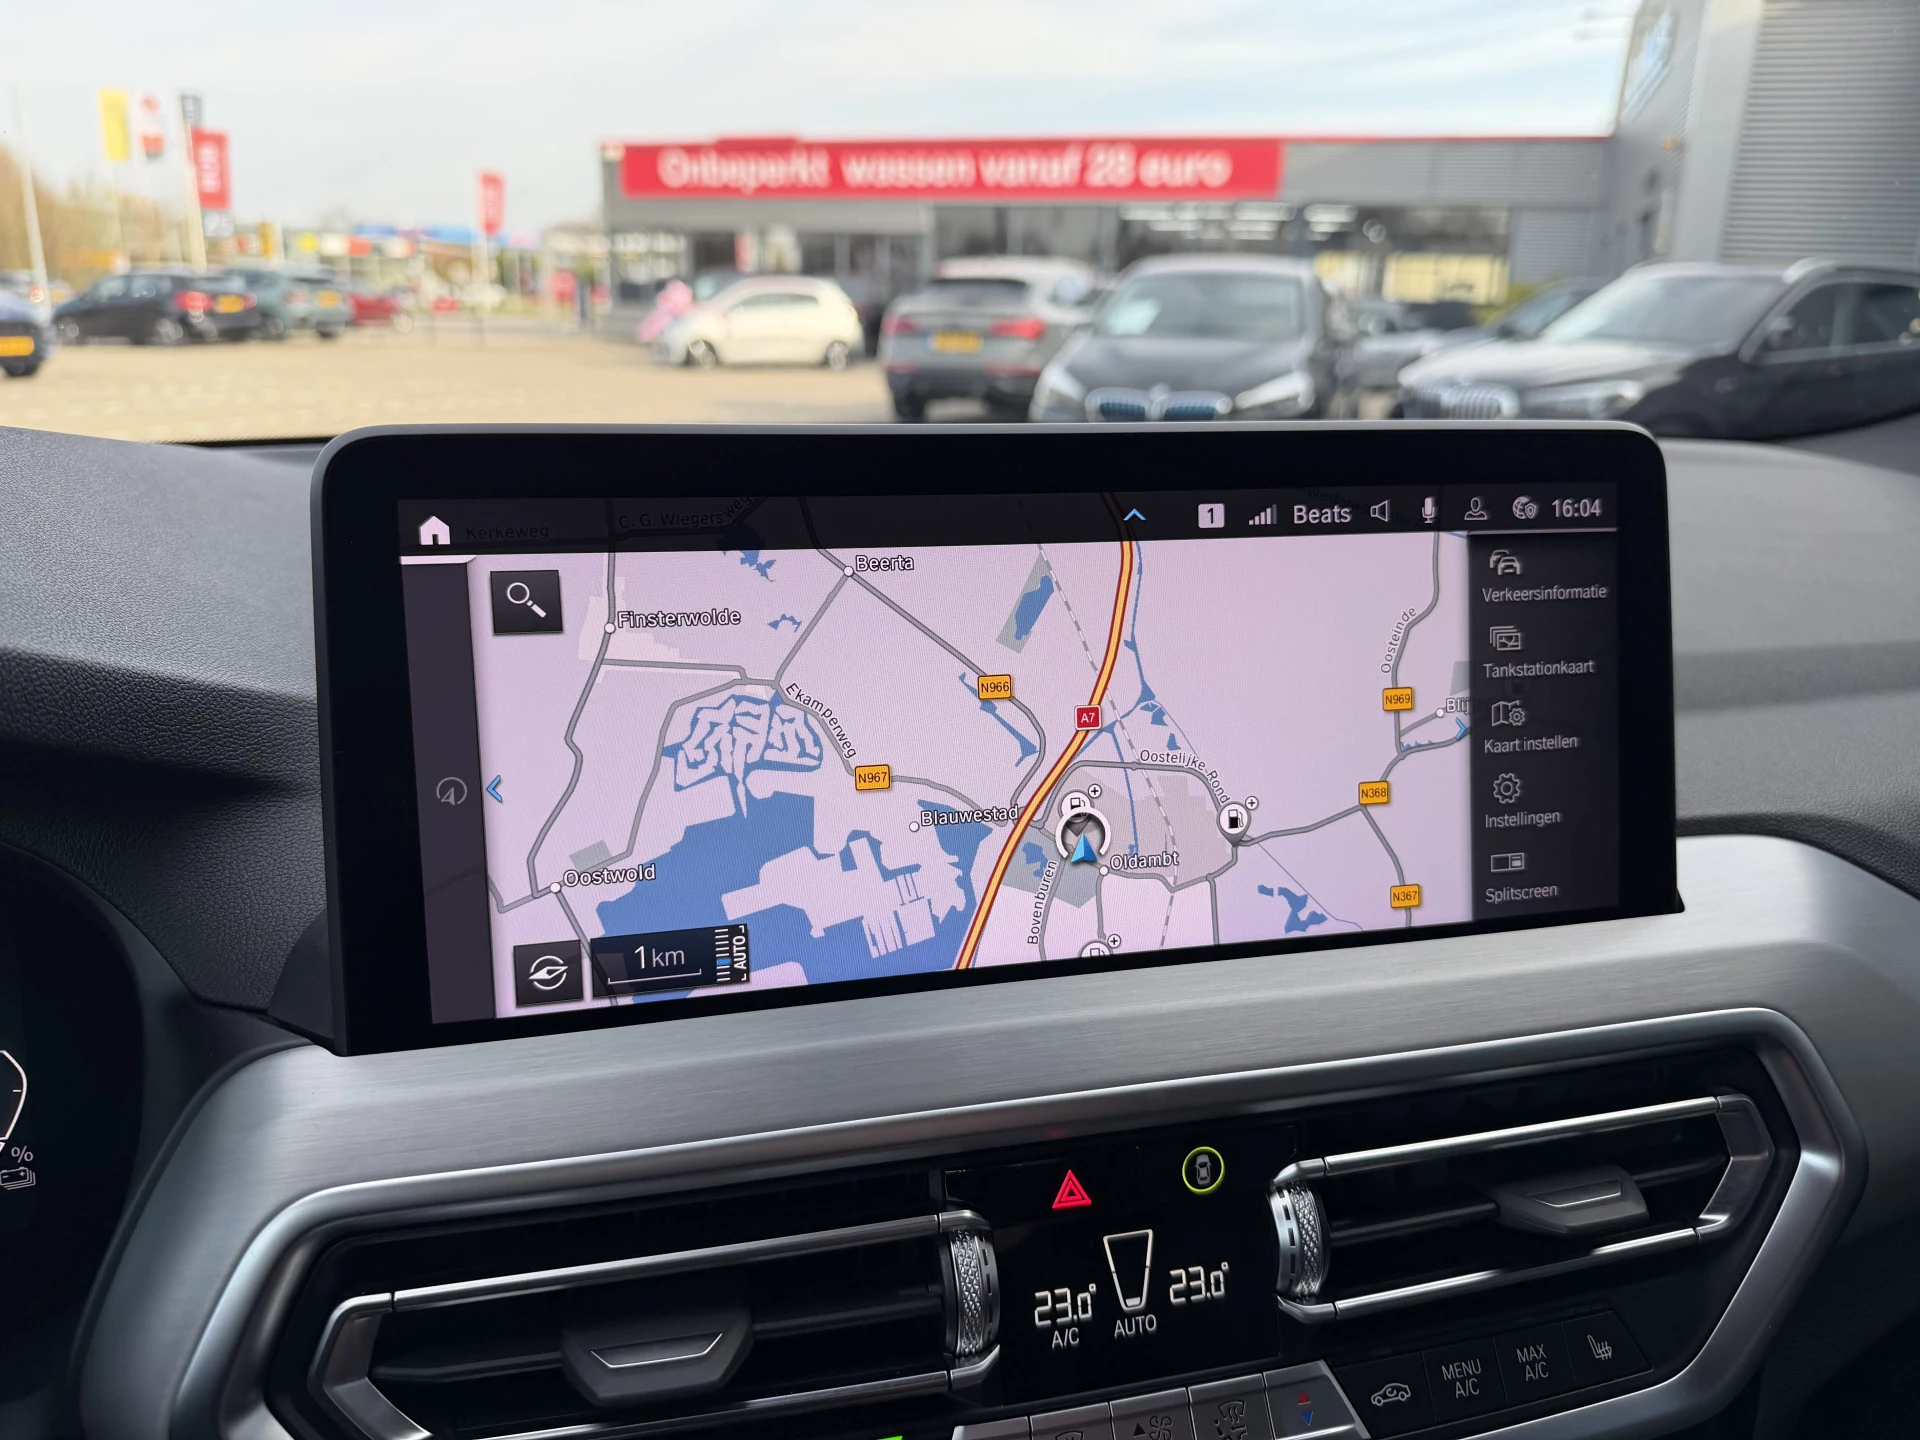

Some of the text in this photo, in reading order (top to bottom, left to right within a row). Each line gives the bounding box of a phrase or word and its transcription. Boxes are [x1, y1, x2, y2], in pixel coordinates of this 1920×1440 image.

[841, 151, 976, 188] wassen
[979, 143, 1084, 188] vanaf
[1139, 150, 1233, 188] euro
[1293, 503, 1351, 525] Beats
[1552, 499, 1602, 518] 16:04
[855, 556, 915, 572] Beerta
[1482, 585, 1607, 603] Verkeersinformatie
[617, 609, 742, 629] Finsterwolde
[1380, 607, 1417, 674] Oosteinde
[1483, 659, 1596, 678] Tankstationkaart
[981, 679, 1009, 694] N966
[1385, 693, 1411, 705] N969
[785, 683, 857, 759] Ekamperweg
[1081, 711, 1095, 725] A7
[1484, 734, 1578, 753] Kaart instellen
[1140, 749, 1206, 771] Oostelijke
[858, 772, 887, 784] N967
[1361, 786, 1387, 800] N368
[920, 804, 1019, 827] Blauwestad
[1484, 811, 1561, 830] Instellingen
[1110, 851, 1179, 870] Oldambt
[563, 865, 656, 887] Oostwold
[1027, 860, 1057, 945] Bovenburen
[1392, 890, 1419, 903] N367
[1485, 884, 1558, 903] Splitscreen
[651, 948, 686, 968] km
[732, 935, 747, 970] AUTO
[1113, 1313, 1158, 1338] AUTO
[1051, 1326, 1080, 1348] A/C
[1516, 1343, 1548, 1364] MAX
[1441, 1358, 1482, 1382] MENU
[1524, 1361, 1550, 1382] A/C
[1454, 1377, 1480, 1399] A/C
